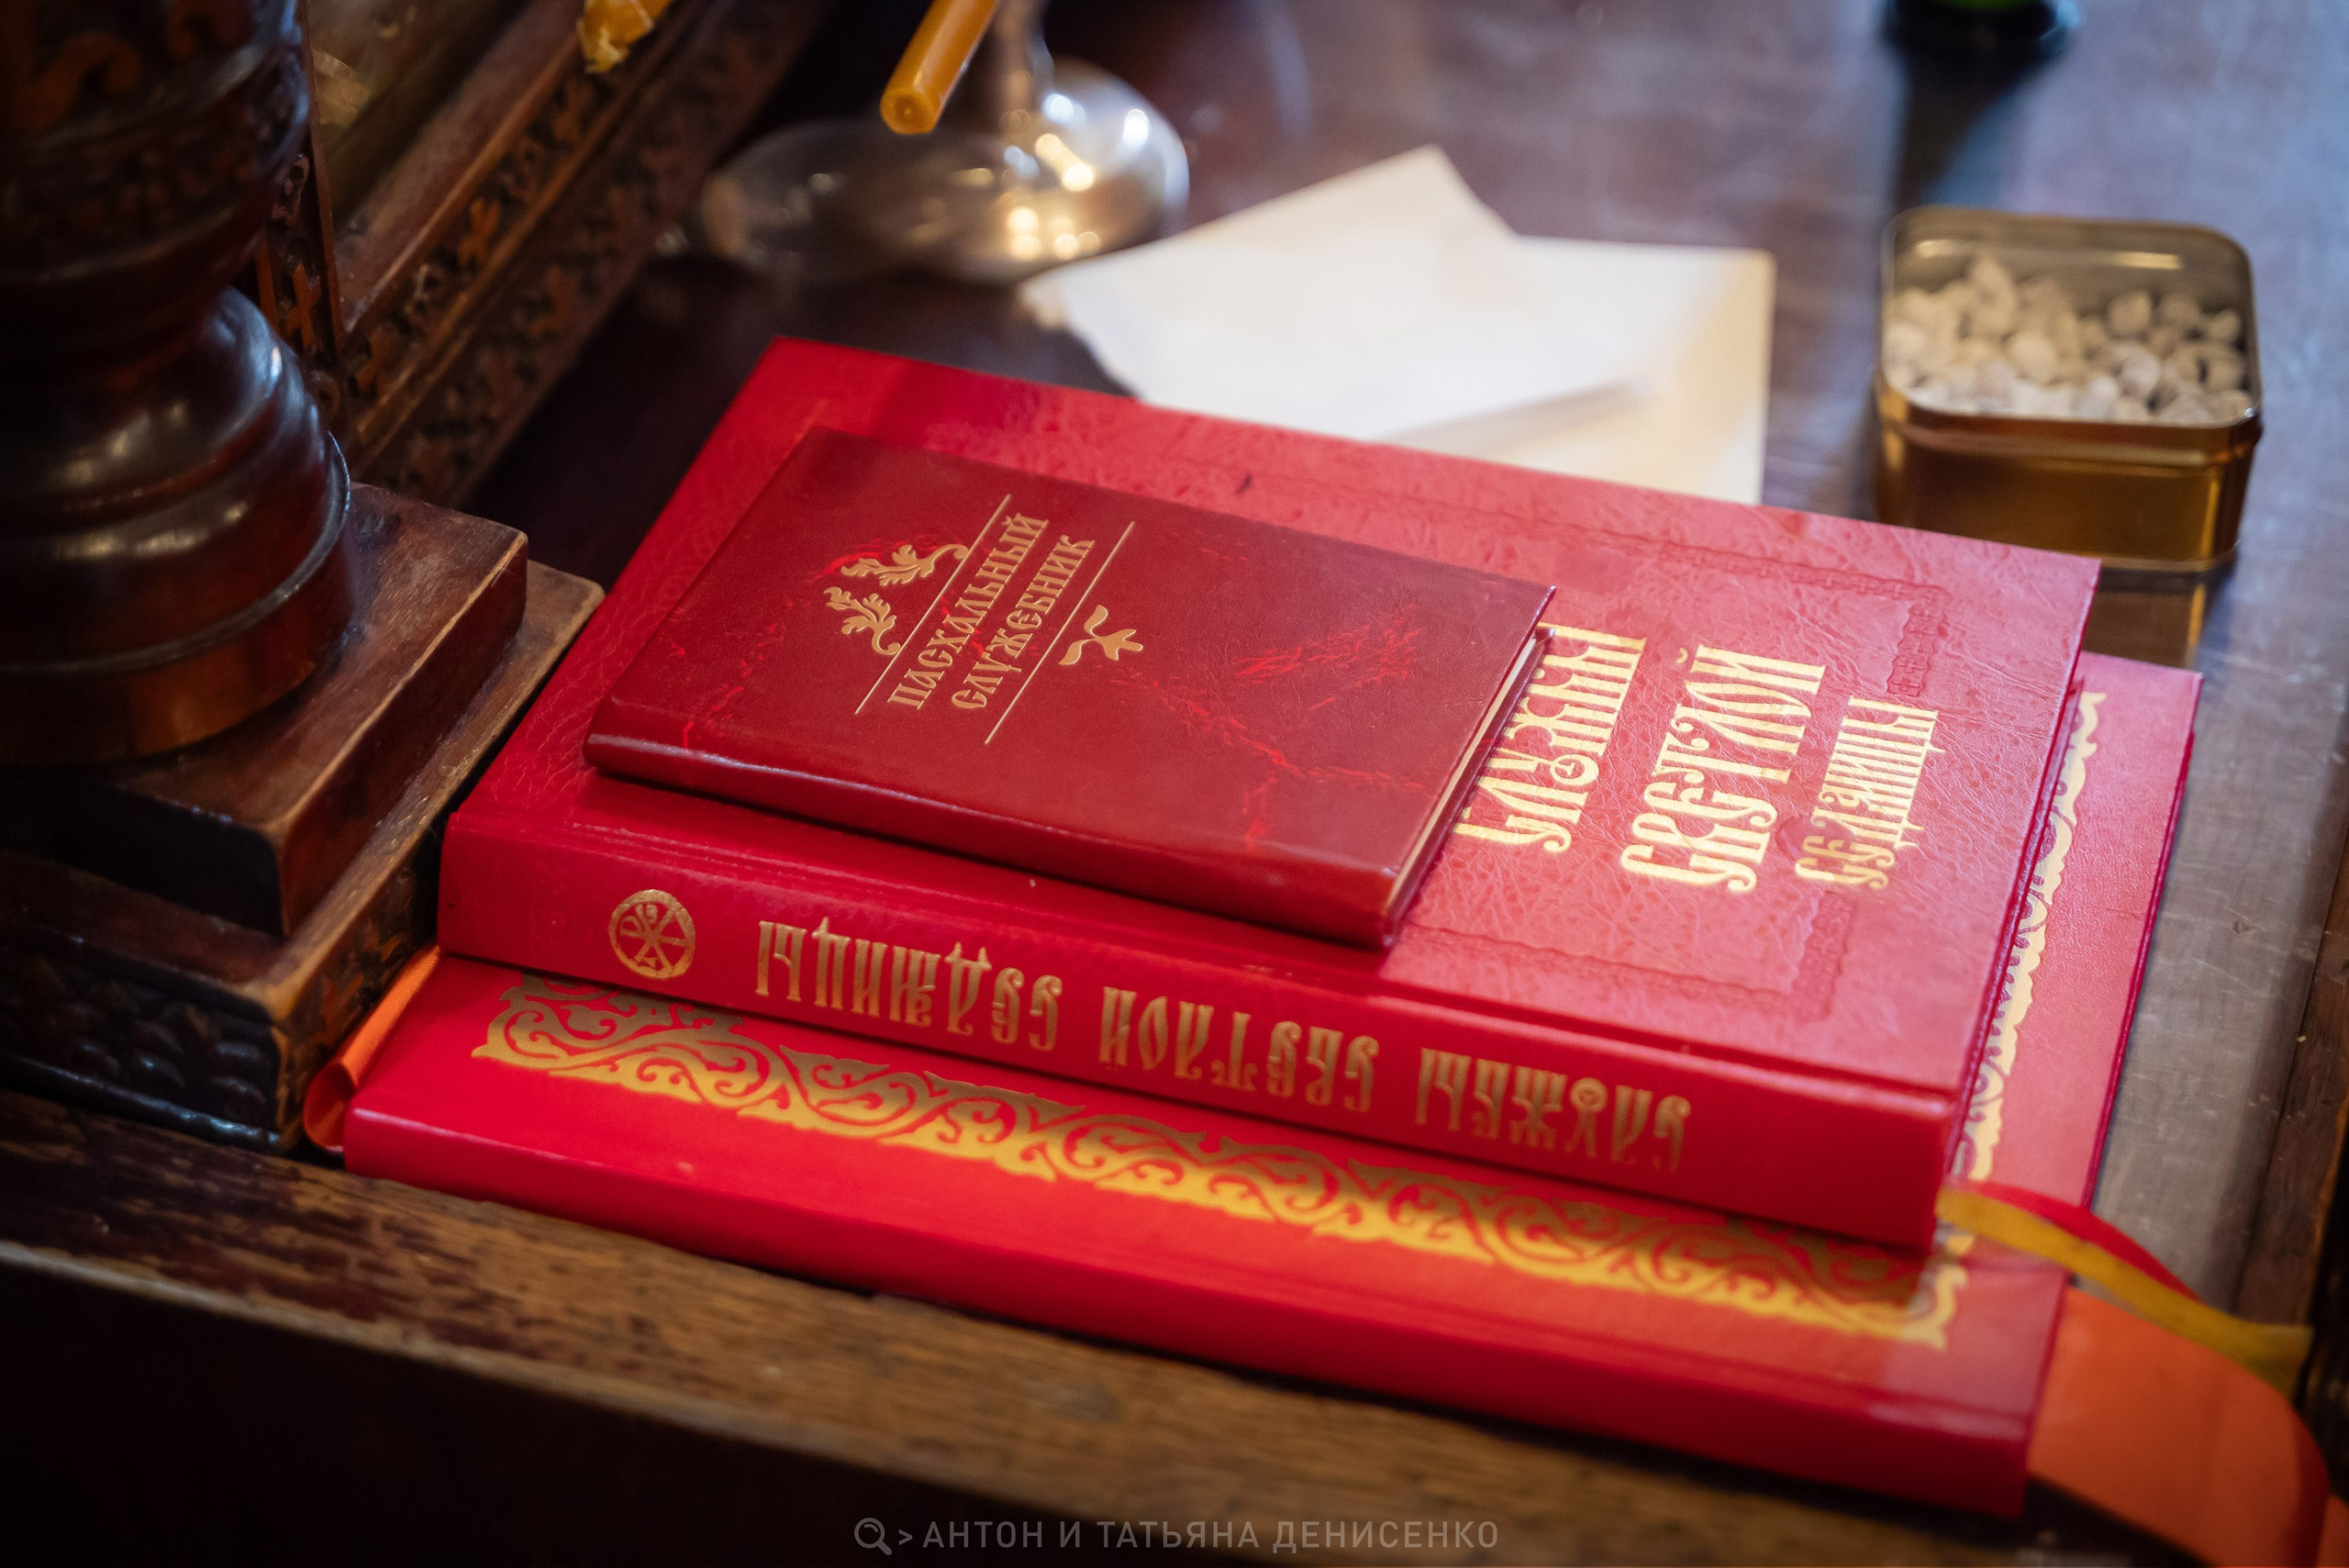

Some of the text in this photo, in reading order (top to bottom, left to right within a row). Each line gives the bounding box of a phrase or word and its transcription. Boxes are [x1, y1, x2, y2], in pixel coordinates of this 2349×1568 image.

[887, 512, 1050, 710] ПАСХАЛЬНЫЙ
[951, 534, 1096, 709] СЛУЖЕБНИК
[1620, 643, 1827, 894] СВЕТЛОЙ
[1795, 695, 1946, 890] СЕДМИЦЫ
[753, 916, 1065, 1052] СЕДМИЦЫ
[1415, 1046, 1693, 1172] СЛУЖБЫ
